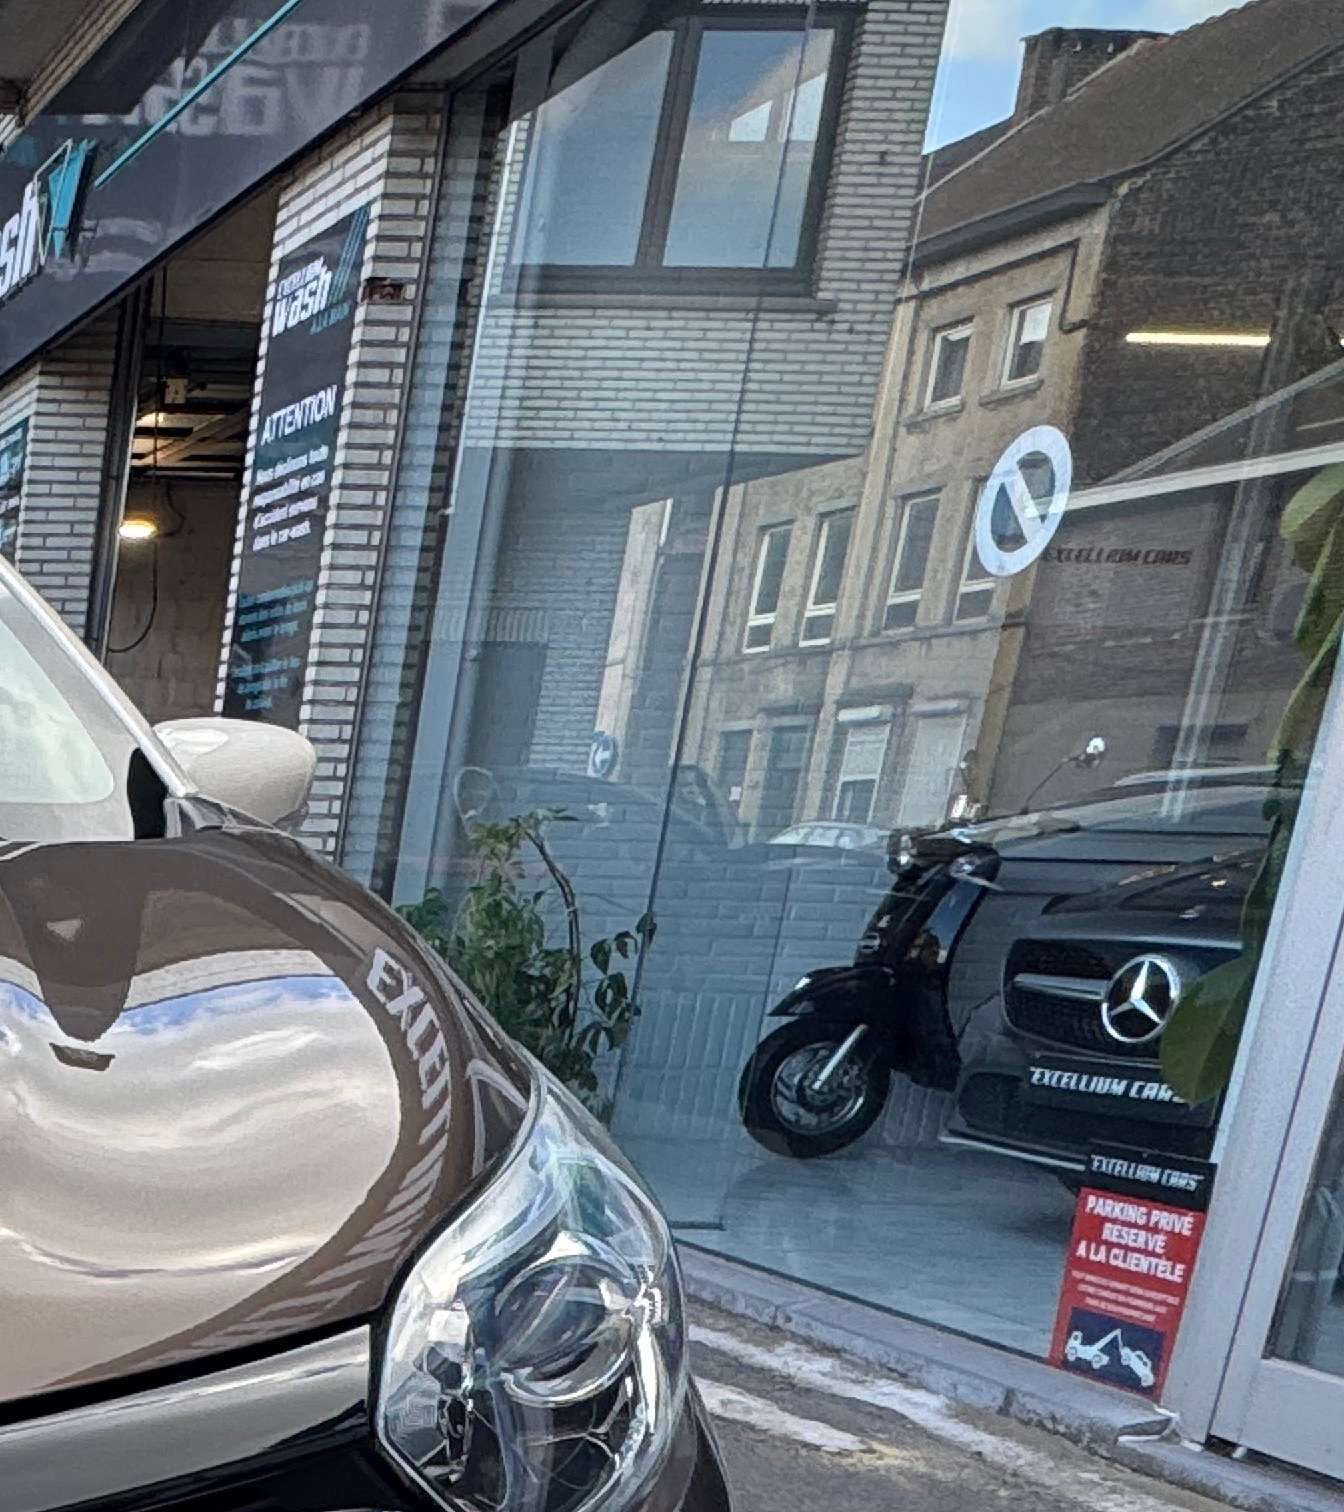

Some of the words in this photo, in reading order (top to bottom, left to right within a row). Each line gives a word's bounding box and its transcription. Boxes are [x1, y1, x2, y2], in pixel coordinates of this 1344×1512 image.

[261, 384, 338, 446] ATTENTION
[1128, 1080, 1186, 1103] CAR
[1085, 1194, 1148, 1226] PARKING
[1088, 1243, 1107, 1264] LA
